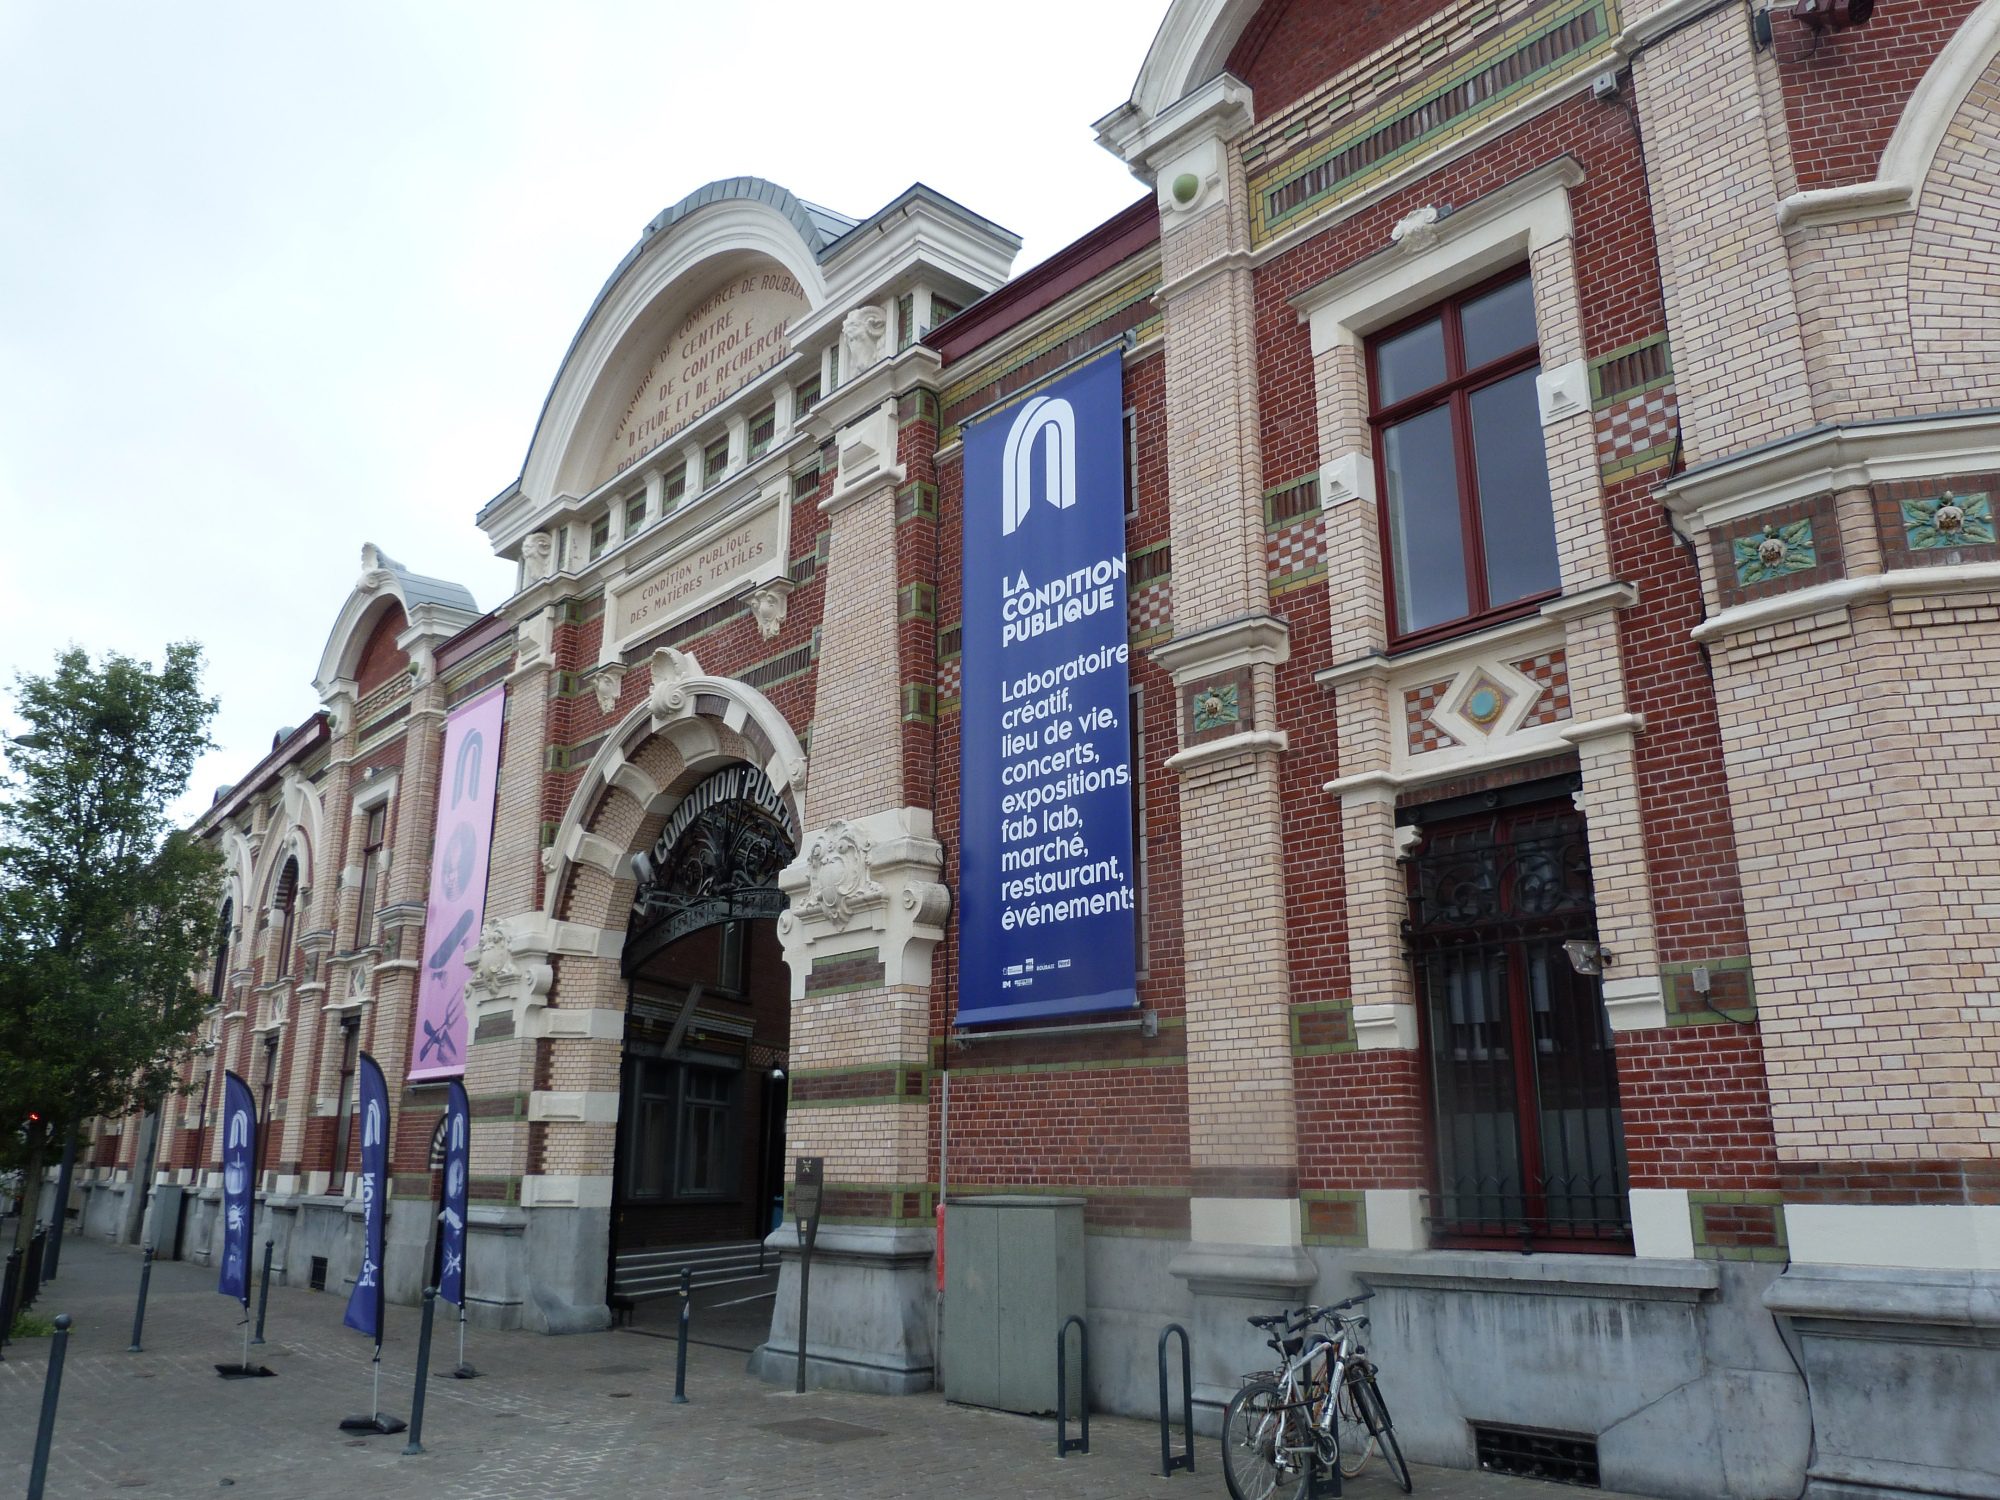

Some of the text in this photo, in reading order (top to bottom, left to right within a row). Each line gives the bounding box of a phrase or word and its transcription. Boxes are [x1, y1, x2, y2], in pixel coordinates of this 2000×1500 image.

[615, 274, 804, 440] CHAMBRE DE COMMERCE DE ROUBAIX
[682, 308, 735, 359] CENTRE
[660, 317, 754, 402] DE CONTROLE
[677, 389, 690, 413] ET
[696, 380, 710, 400] DE
[630, 605, 648, 624] DES
[711, 542, 763, 579] TEXTILES
[642, 530, 751, 600] CONDITION PUBLIQUE
[1002, 552, 1127, 621] CONDITION
[1003, 569, 1030, 598] LA
[1003, 584, 1114, 647] PUBLIQUE
[1002, 643, 1129, 703] Laboratoire
[1002, 687, 1072, 729] créatif,
[1002, 707, 1118, 757] lieu de vie,
[1002, 742, 1100, 786] concerts,
[655, 767, 740, 864] CONDITION
[1002, 805, 1083, 843] fab lab,
[1002, 831, 1089, 872] marché,
[1002, 856, 1124, 901] restaurant,
